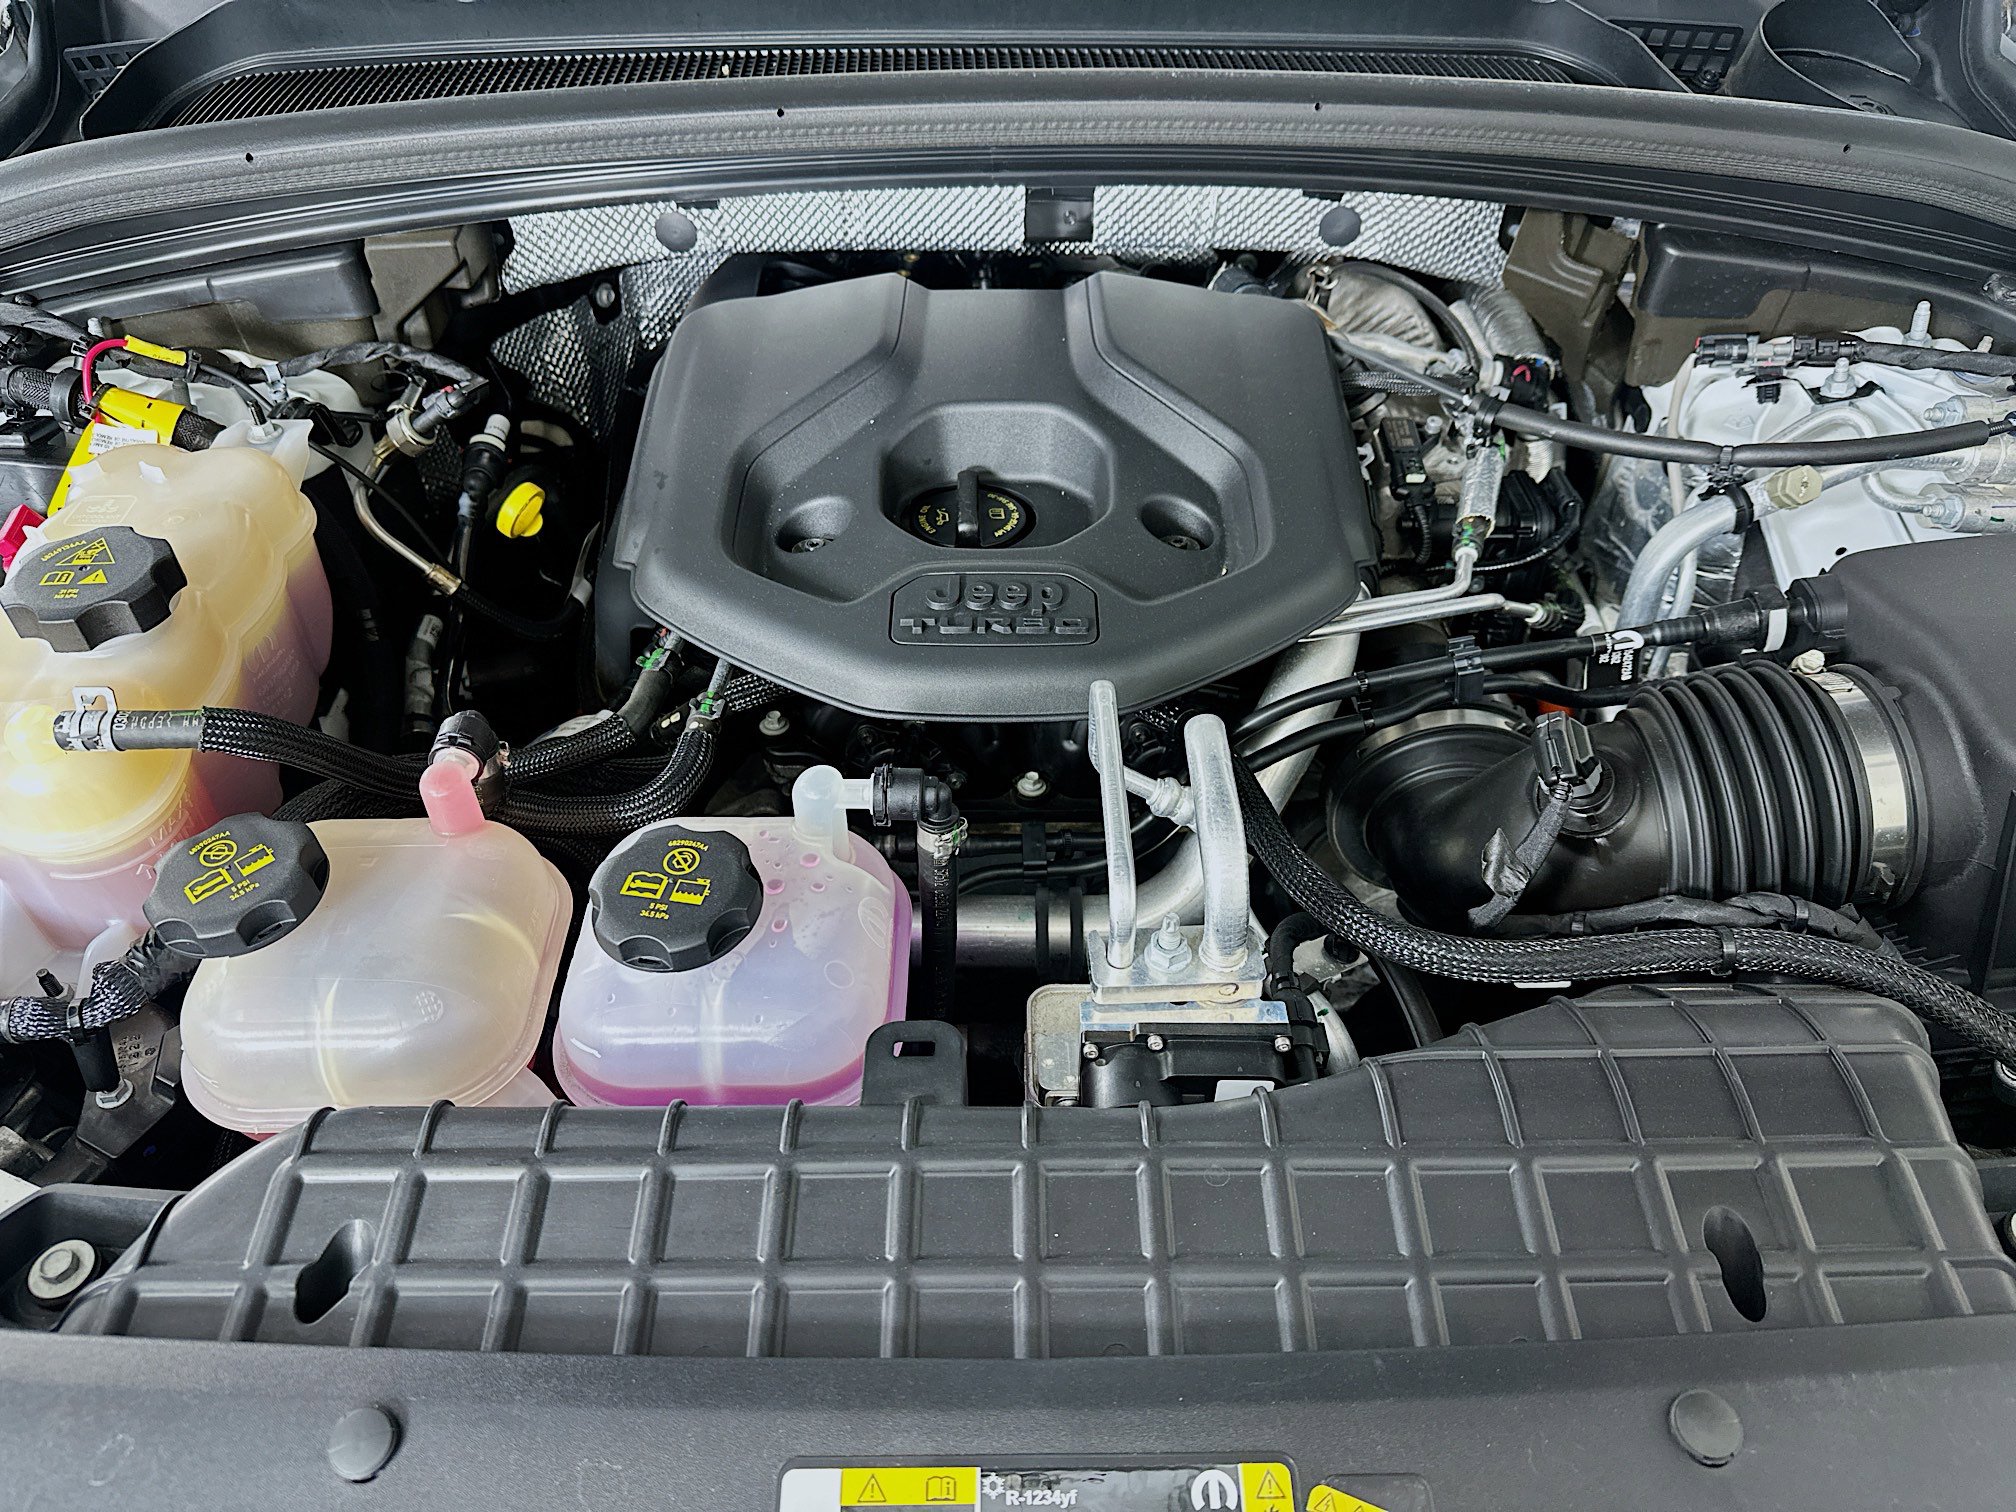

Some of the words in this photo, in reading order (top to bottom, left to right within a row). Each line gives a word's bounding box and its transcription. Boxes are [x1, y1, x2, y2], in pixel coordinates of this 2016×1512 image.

[925, 574, 1063, 616] Jeep
[899, 616, 1090, 635] TURBO
[229, 890, 244, 901] 34.5
[244, 882, 260, 894] kPa
[238, 879, 250, 888] PSI
[639, 910, 655, 918] 34.5
[655, 911, 669, 920] kPa
[655, 903, 668, 911] PSI
[1005, 1489, 1078, 1509] R-1234yf
